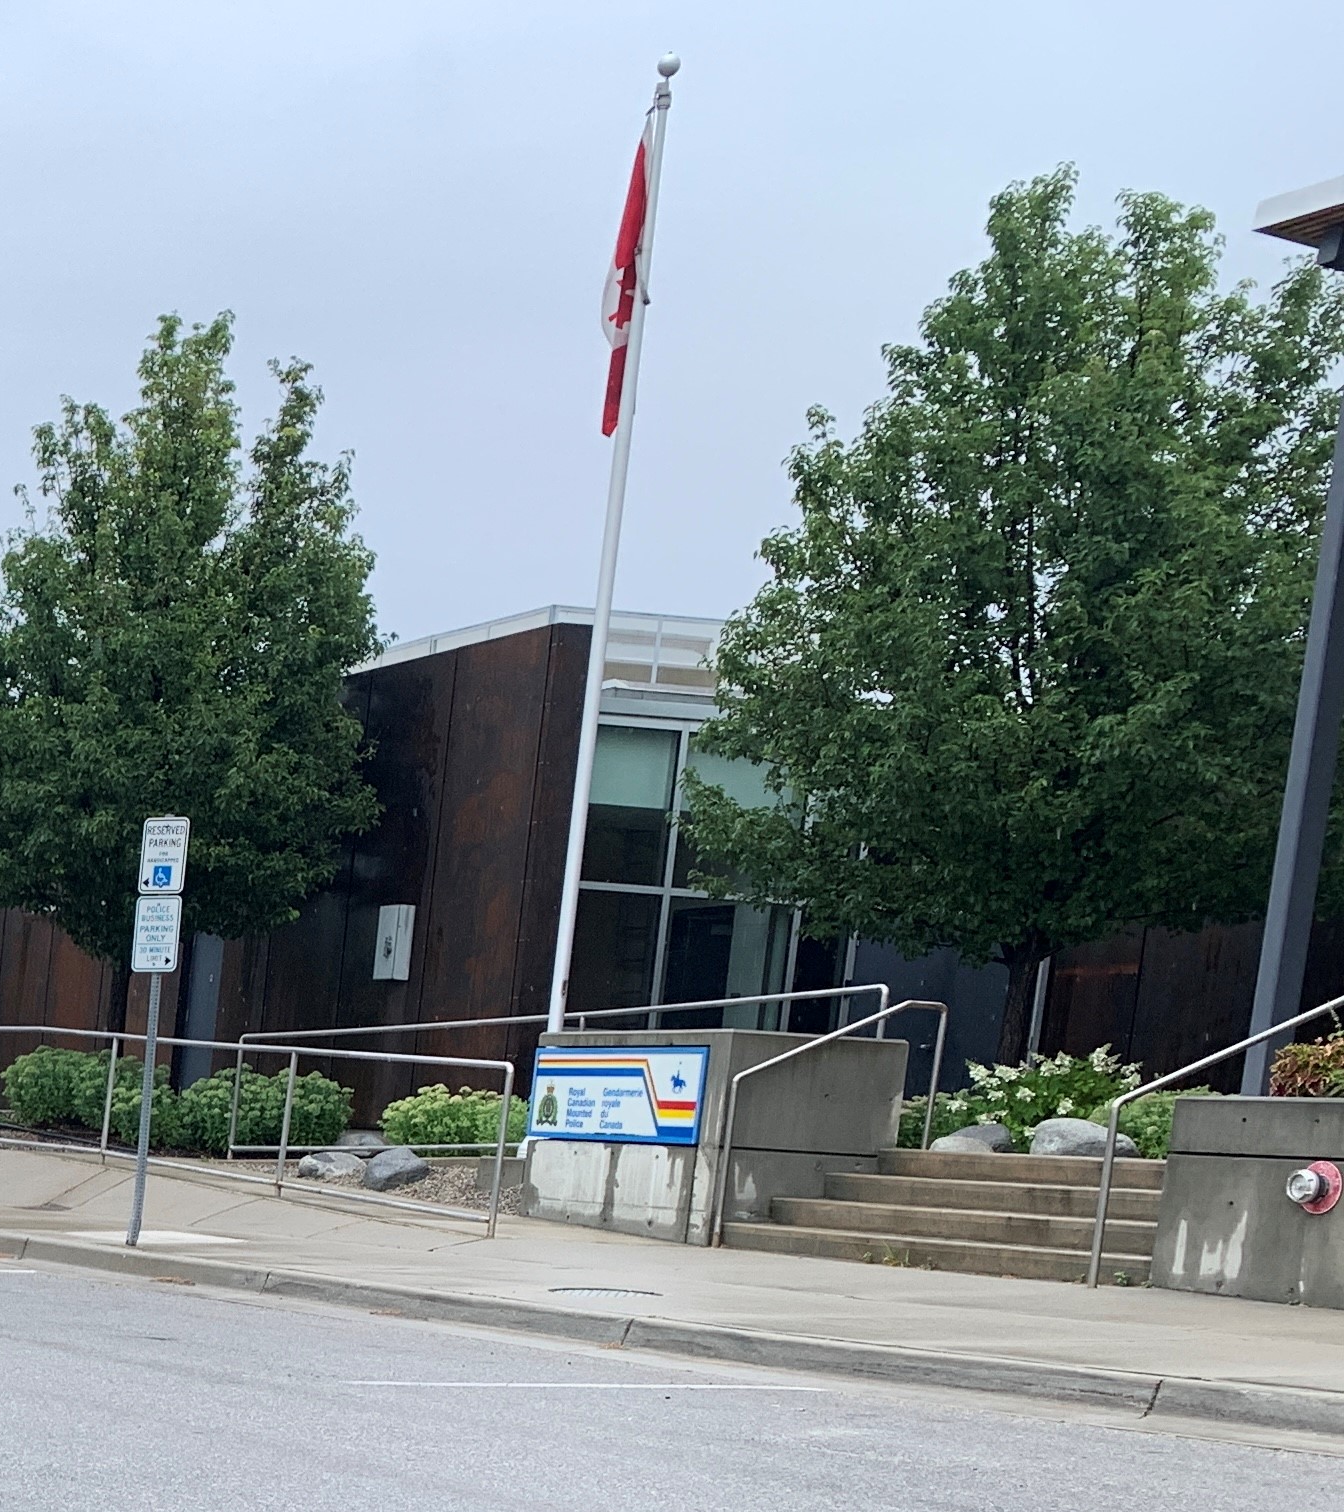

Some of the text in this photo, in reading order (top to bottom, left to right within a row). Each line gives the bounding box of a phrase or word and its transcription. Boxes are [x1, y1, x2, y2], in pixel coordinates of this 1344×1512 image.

[147, 825, 185, 835] RESERVED
[148, 838, 181, 848] PARKING
[146, 905, 170, 913] POLICE
[141, 914, 174, 922] BUSINESS
[140, 925, 174, 933] PARKING
[145, 934, 166, 942] ONLY
[139, 946, 171, 954] 30 MINUTE
[569, 1087, 586, 1098] Royal
[603, 1087, 643, 1097] Gendarmerie
[567, 1097, 596, 1107] Canadian
[601, 1099, 621, 1109] royale
[566, 1108, 593, 1118] Mounted
[600, 1110, 609, 1118] du
[565, 1119, 584, 1128] Police
[599, 1119, 623, 1130] Canada
